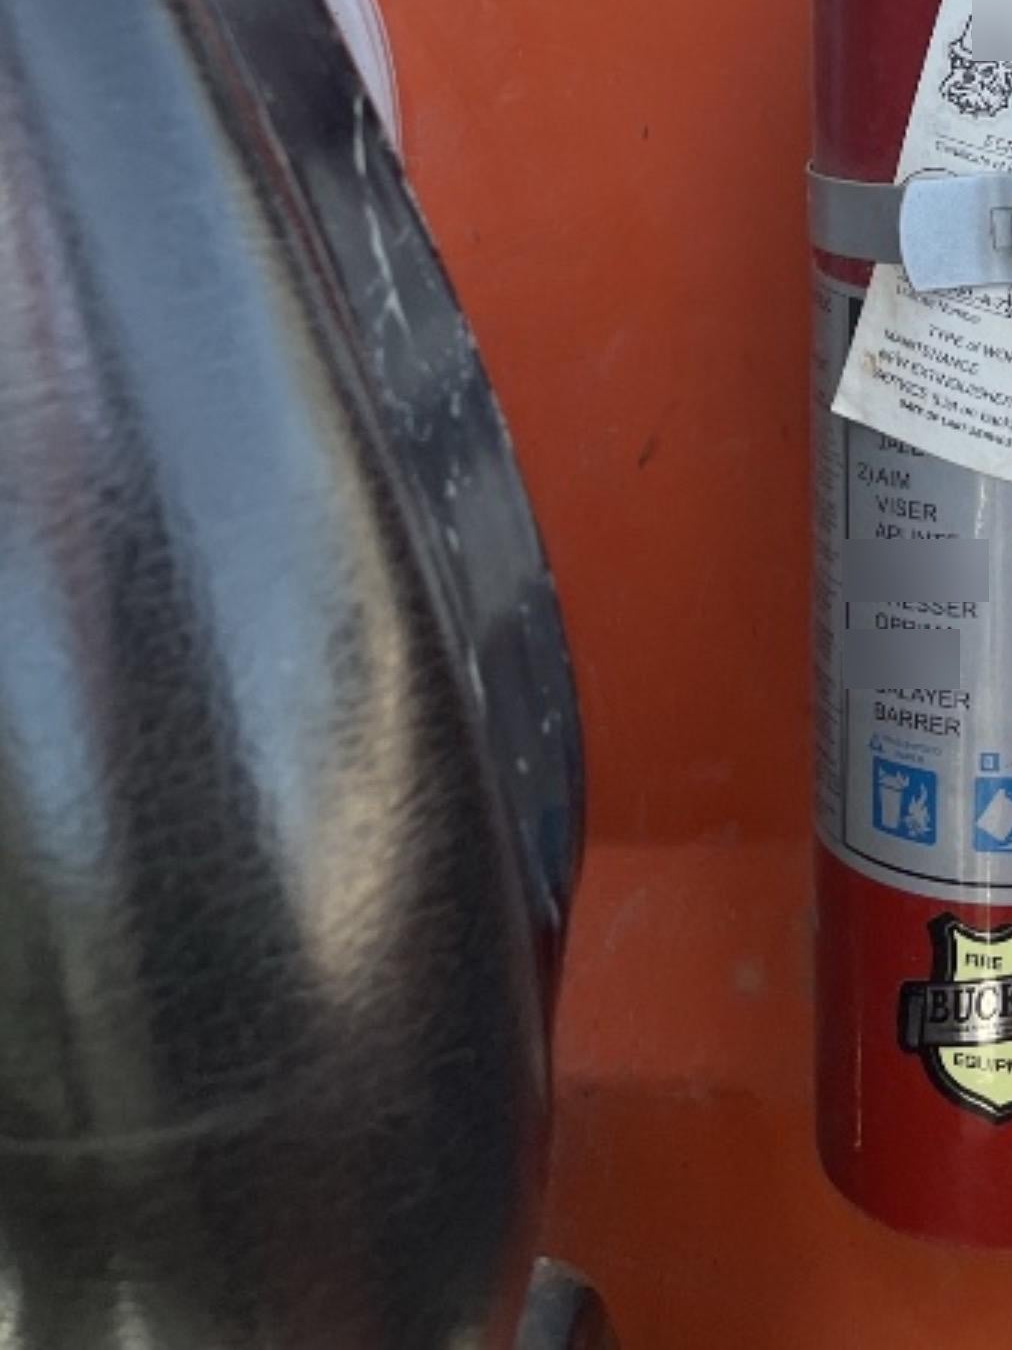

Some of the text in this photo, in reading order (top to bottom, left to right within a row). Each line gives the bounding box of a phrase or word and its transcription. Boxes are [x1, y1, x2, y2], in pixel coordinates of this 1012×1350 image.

[875, 494, 937, 523] VISER
[874, 701, 961, 737] BARRER
[964, 952, 1003, 971] FIRE
